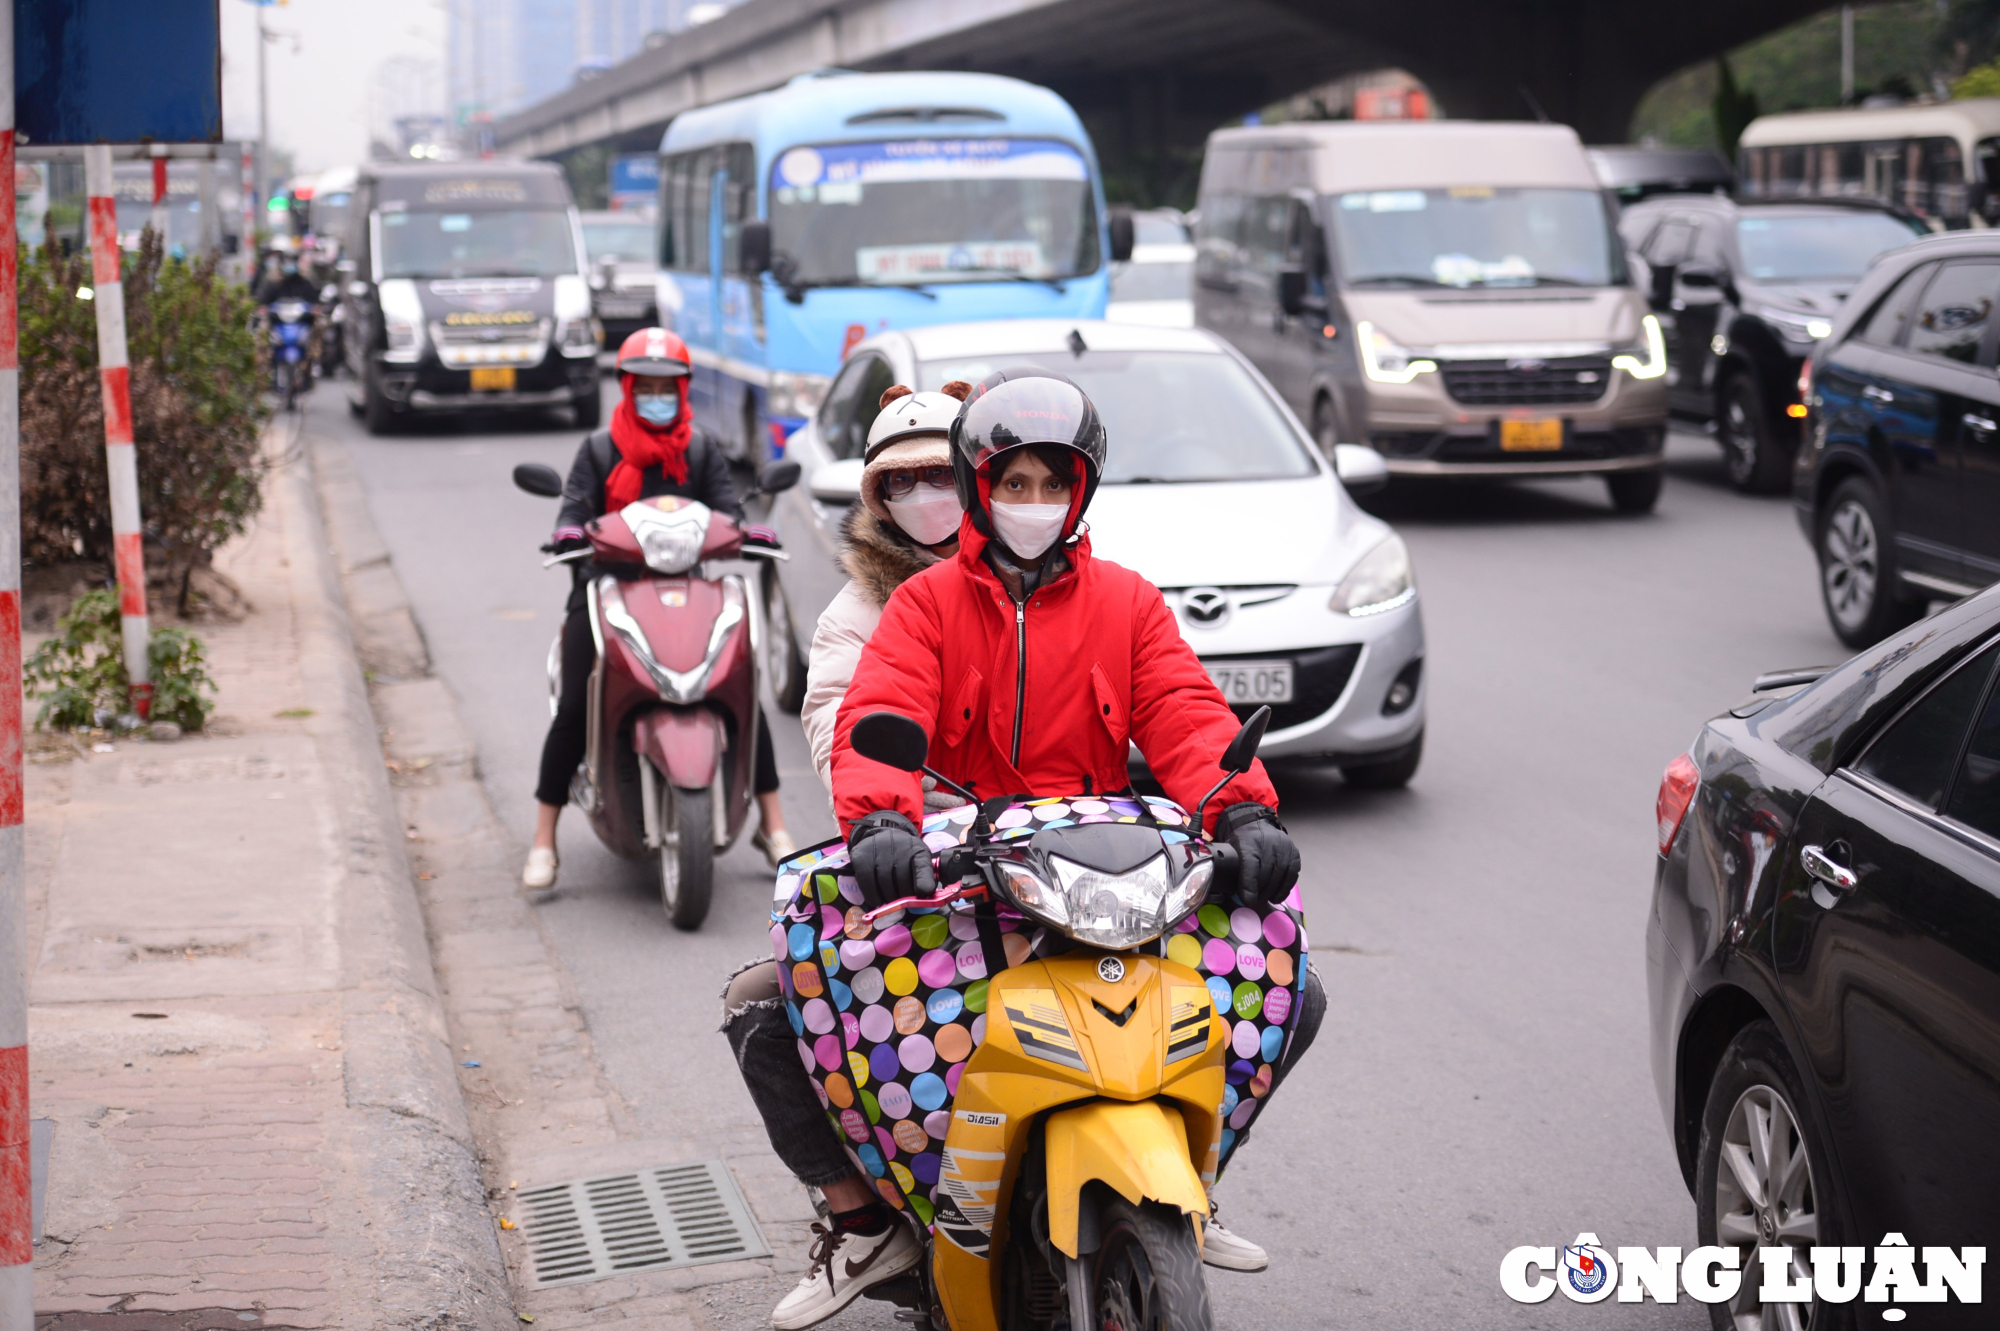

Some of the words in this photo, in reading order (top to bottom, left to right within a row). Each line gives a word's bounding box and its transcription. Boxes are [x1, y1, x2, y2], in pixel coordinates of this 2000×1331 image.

[1016, 410, 1071, 422] HONDA
[1209, 670, 1286, 698] 76.05
[841, 881, 859, 893] OVE
[958, 953, 983, 967] LOV
[1239, 954, 1264, 968] LOVE
[794, 970, 822, 990] LOVE
[854, 976, 882, 992] LOVE
[1210, 989, 1230, 1002] OVE
[1269, 989, 1284, 997] Love
[929, 997, 961, 1013] LOVE
[1236, 990, 1261, 1012] zj004
[843, 1021, 858, 1035] VE
[881, 1093, 910, 1108] LOVE
